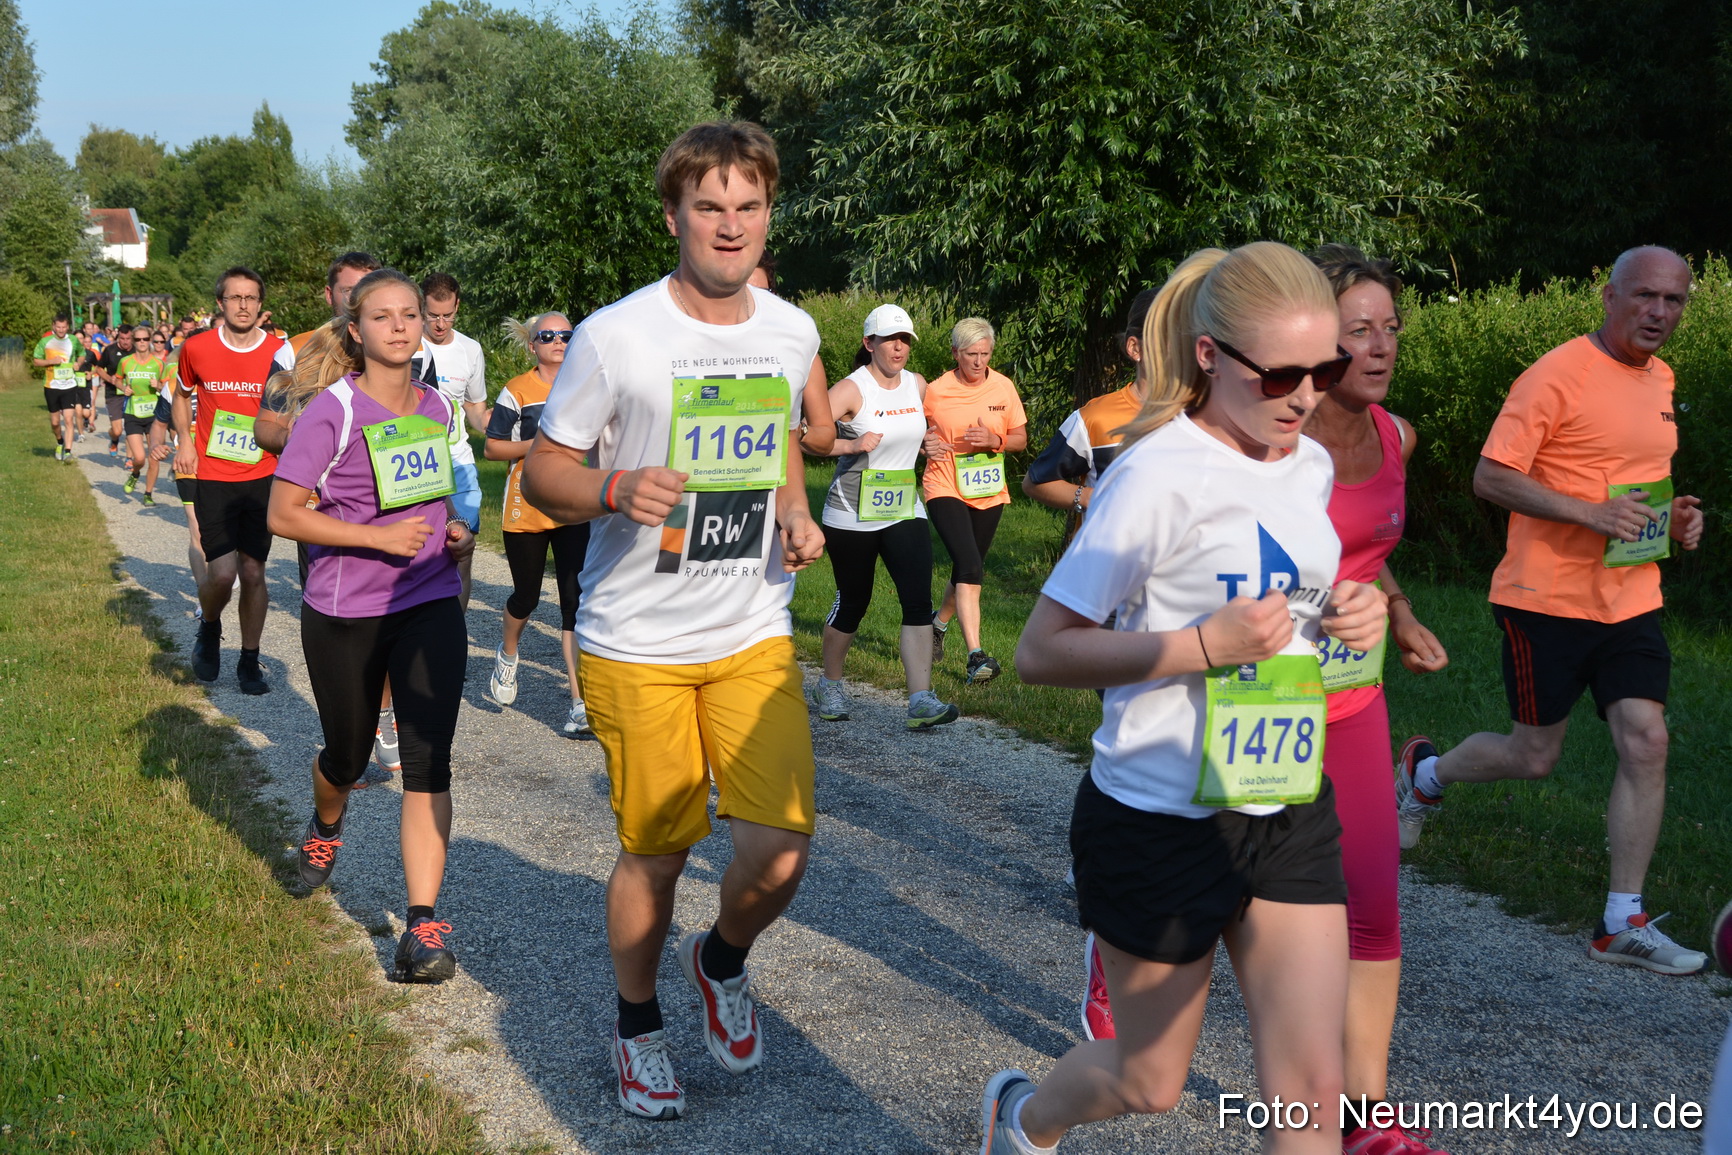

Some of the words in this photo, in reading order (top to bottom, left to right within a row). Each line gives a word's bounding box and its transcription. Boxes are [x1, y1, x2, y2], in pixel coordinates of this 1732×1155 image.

[672, 360, 688, 368] DIE
[693, 358, 717, 367] NEUE
[723, 356, 780, 366] WOHNFORMEL
[203, 381, 262, 393] NEUMARKT
[139, 403, 154, 411] 154
[692, 397, 735, 406] firmenlauf
[886, 407, 919, 416] KLEBL
[217, 430, 258, 451] 1418
[685, 423, 776, 461] 1164
[391, 446, 439, 482] 294
[693, 468, 726, 476] Benedikt
[726, 466, 762, 475] Schnuchel
[962, 468, 1001, 486] 1453
[394, 485, 418, 494] Franziska
[872, 490, 904, 507] 591
[751, 503, 765, 512] NM
[701, 512, 749, 546] RW
[1621, 511, 1668, 544] 62
[684, 567, 759, 578] RAUMWERK
[1221, 717, 1315, 764] 1478
[1239, 776, 1255, 785] Lisa
[1256, 775, 1288, 784] Deinhard
